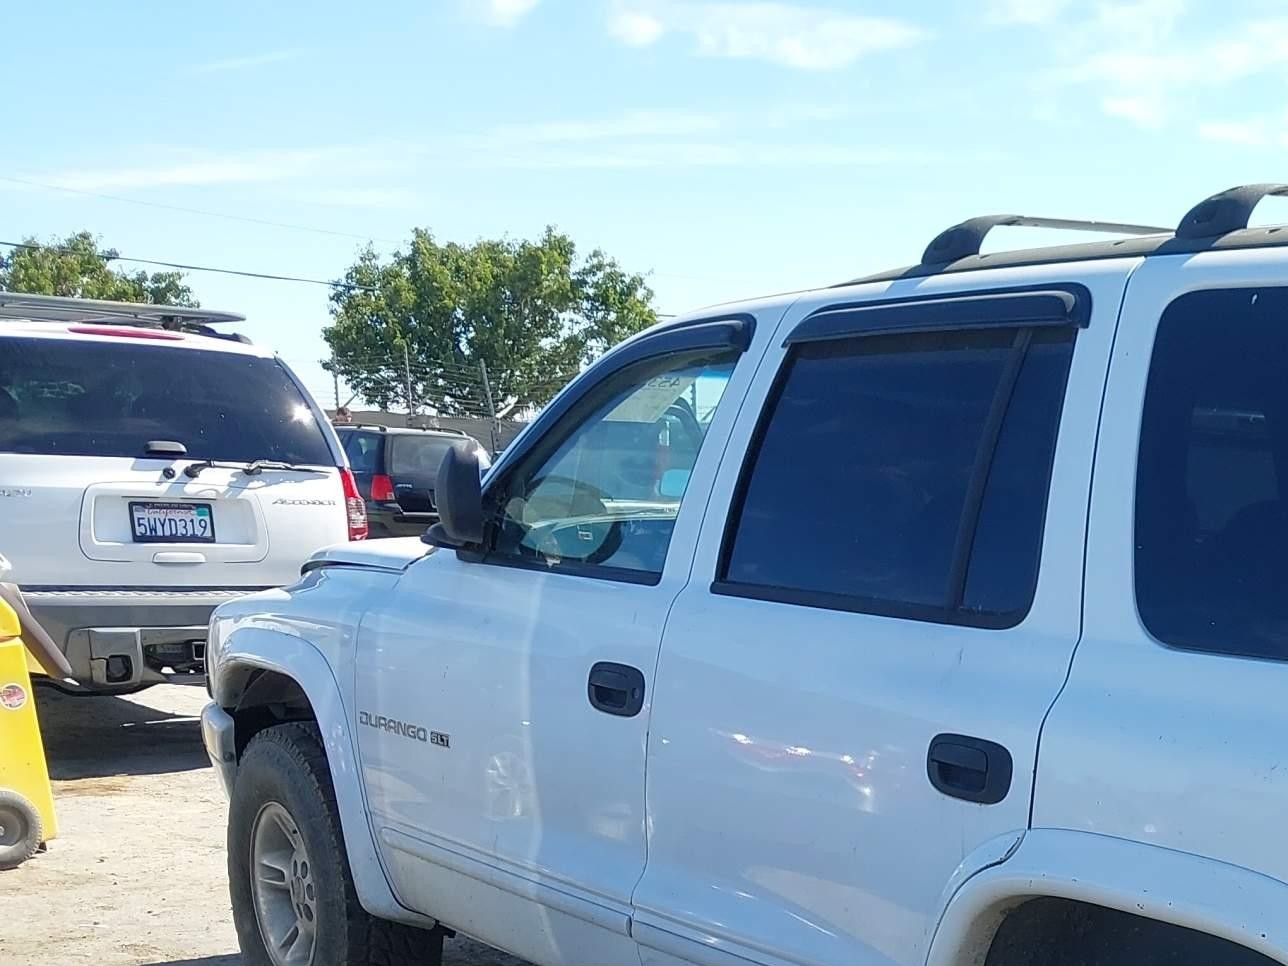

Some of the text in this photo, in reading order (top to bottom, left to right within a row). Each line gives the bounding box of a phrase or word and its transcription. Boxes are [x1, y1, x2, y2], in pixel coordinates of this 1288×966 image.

[137, 517, 208, 537] 5WYD319
[359, 711, 451, 749] DURANGO SLT
